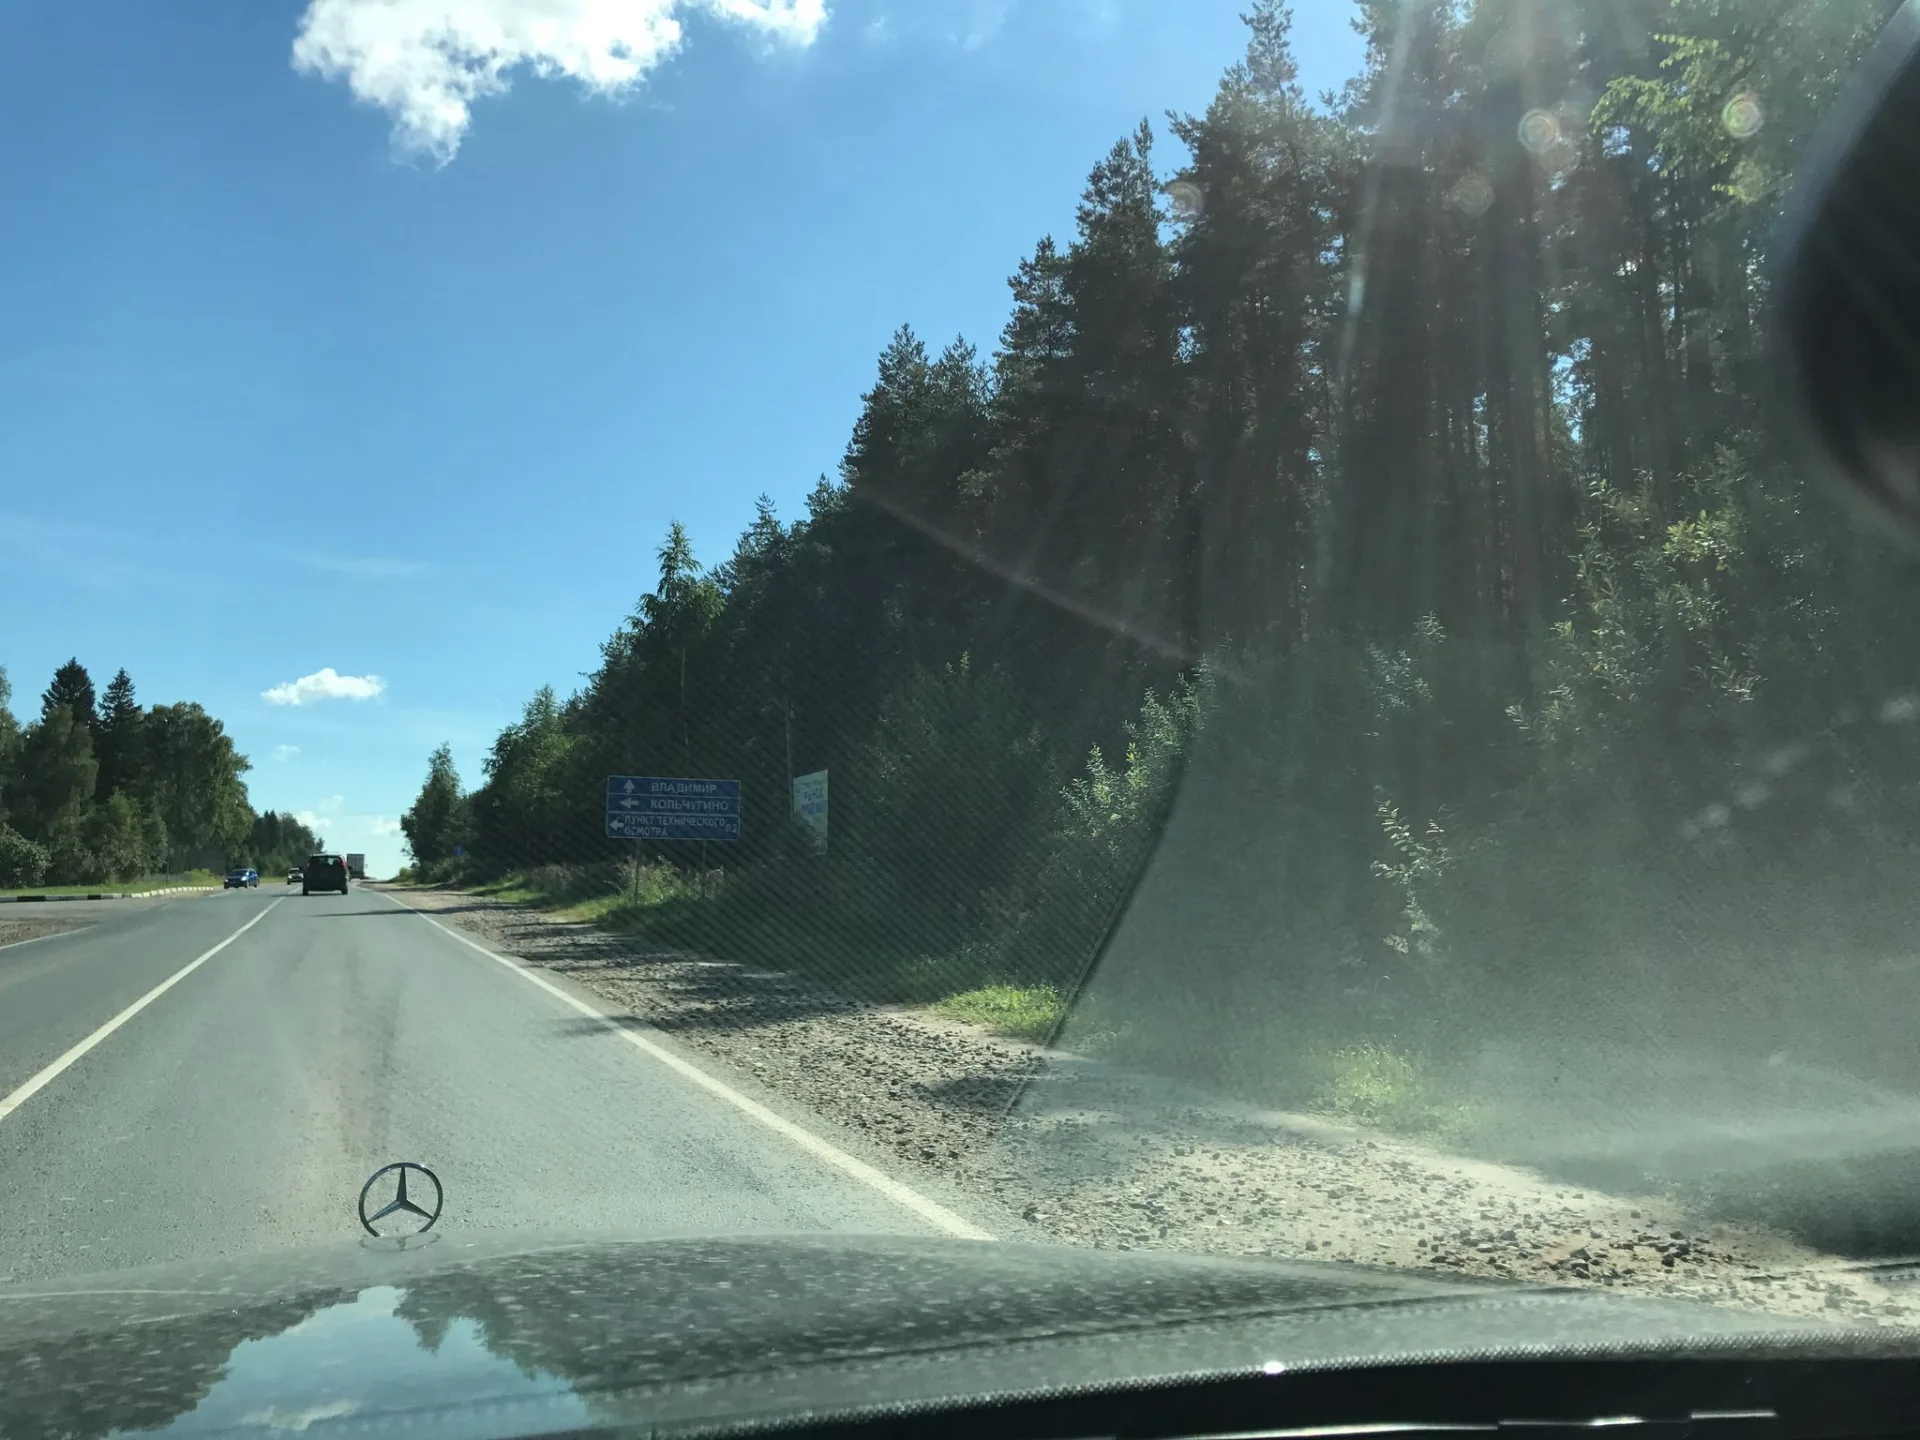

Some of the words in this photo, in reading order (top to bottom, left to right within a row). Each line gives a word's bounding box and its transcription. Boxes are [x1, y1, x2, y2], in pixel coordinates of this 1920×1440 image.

[651, 782, 717, 793] ВЛАДИМИР
[650, 799, 729, 811] КОЛЬЧУГИНО
[624, 815, 654, 824] ПУНКТ
[658, 816, 725, 827] ТЕХНИЧЕСКОГО
[624, 826, 668, 836] ОСМОТРА
